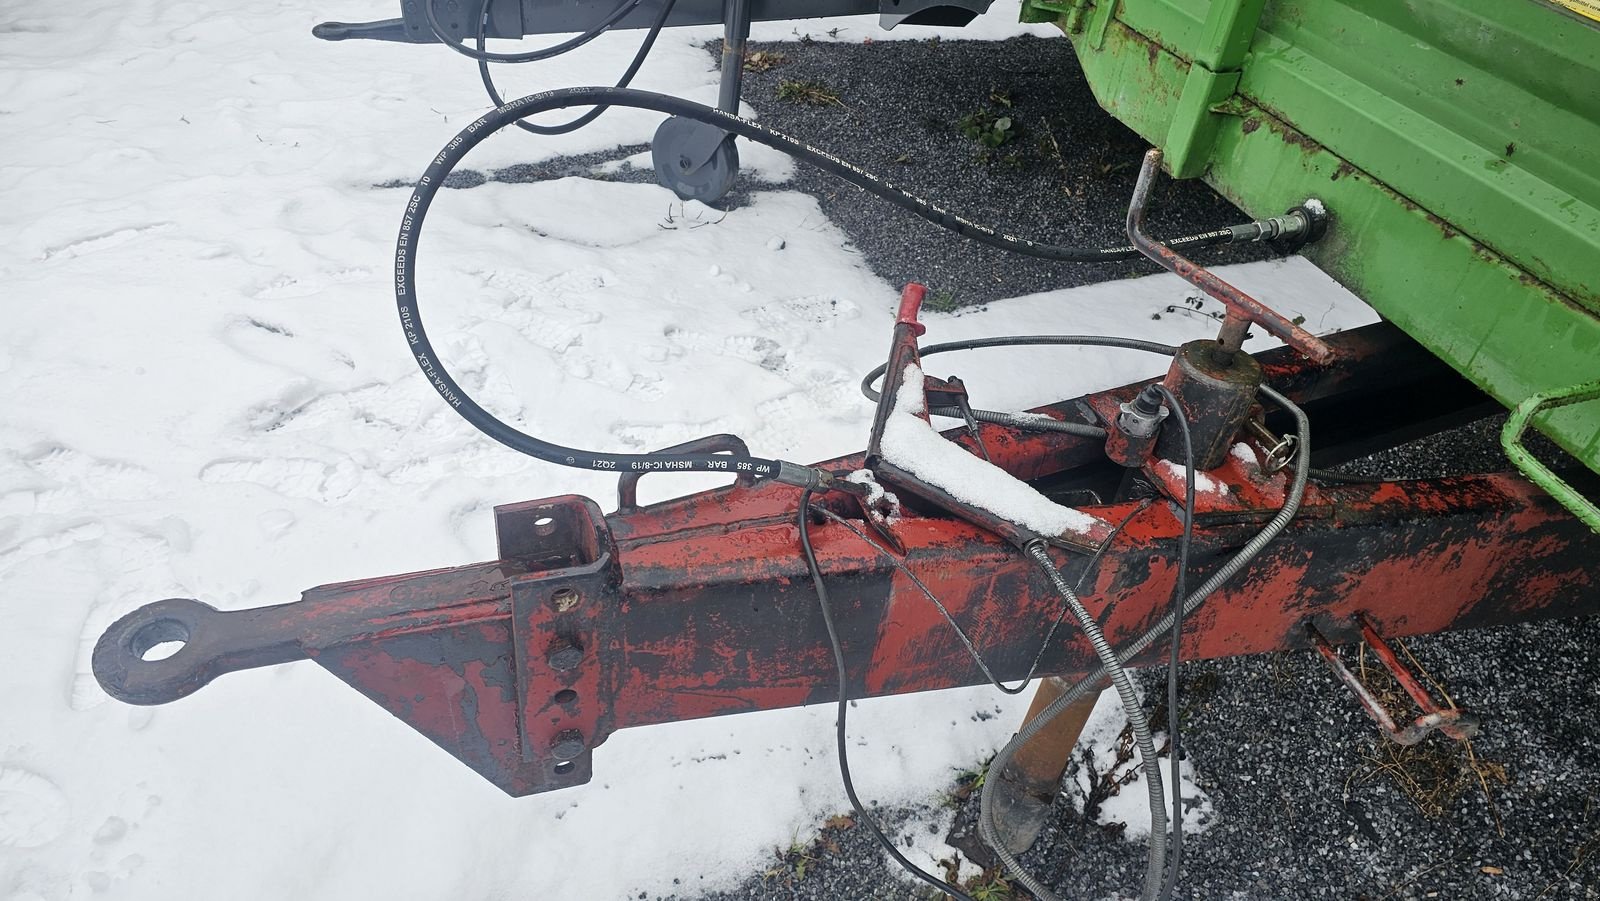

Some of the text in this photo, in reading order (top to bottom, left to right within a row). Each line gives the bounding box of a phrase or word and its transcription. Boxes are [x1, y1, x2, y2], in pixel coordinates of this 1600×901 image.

[467, 118, 487, 133] BAR
[447, 136, 463, 150] 385
[712, 108, 762, 130] HANSA-FLEX
[806, 144, 840, 164] EXCEEDS
[434, 151, 447, 165] WP
[420, 176, 431, 186] 10
[408, 194, 421, 214] 2SC
[402, 215, 413, 231] 857
[400, 233, 408, 247] EN
[396, 249, 406, 296] EXCEEDS
[401, 306, 413, 330] 210S
[408, 331, 419, 345] KP
[418, 353, 462, 408] HANSA-FLEX
[592, 459, 770, 473] WP 385 BAR MSHA IC-8/19 2Q21
